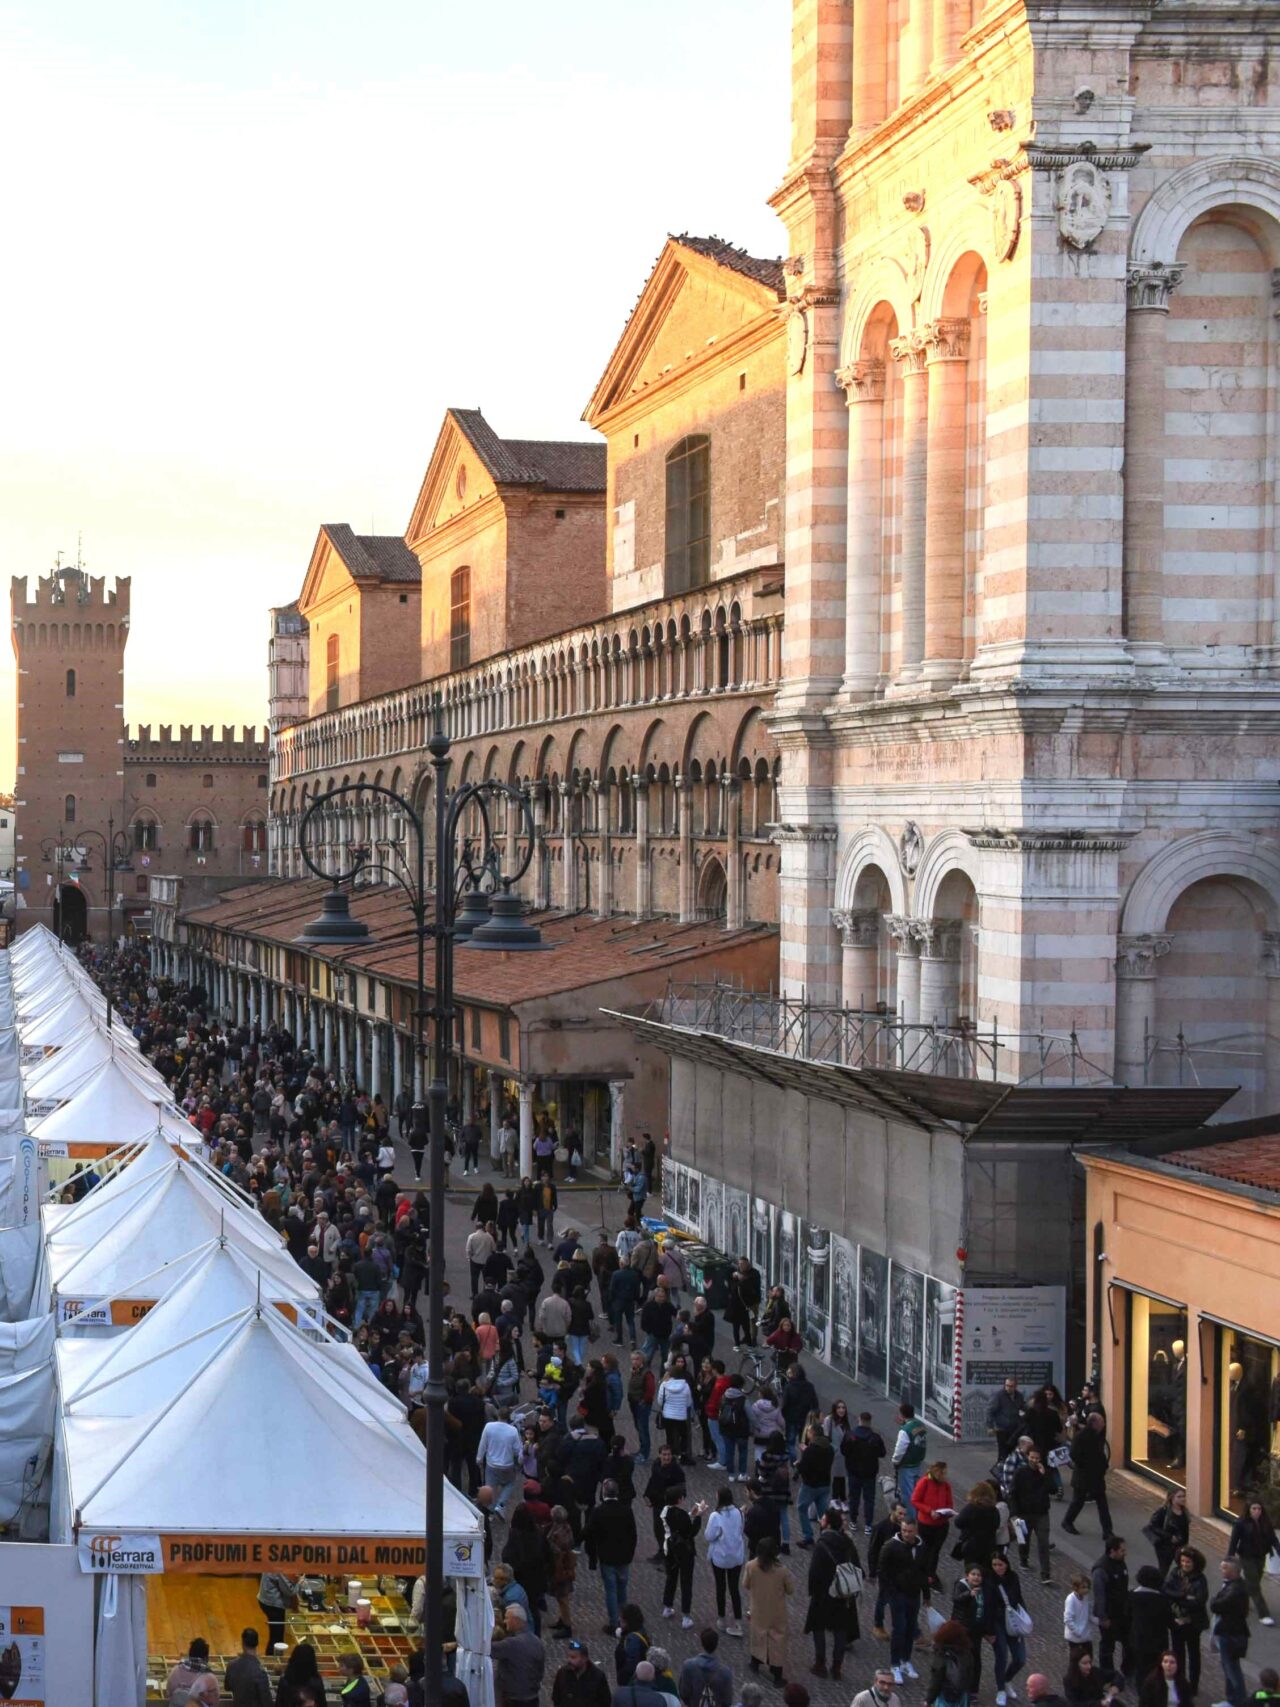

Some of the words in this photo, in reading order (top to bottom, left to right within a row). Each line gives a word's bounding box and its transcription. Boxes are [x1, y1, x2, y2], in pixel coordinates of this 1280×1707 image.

[170, 1543, 246, 1561] PROFUMI
[253, 1544, 262, 1561] E
[268, 1545, 330, 1564] SAPORI
[337, 1545, 369, 1564] DAL
[375, 1547, 426, 1565] MOND
